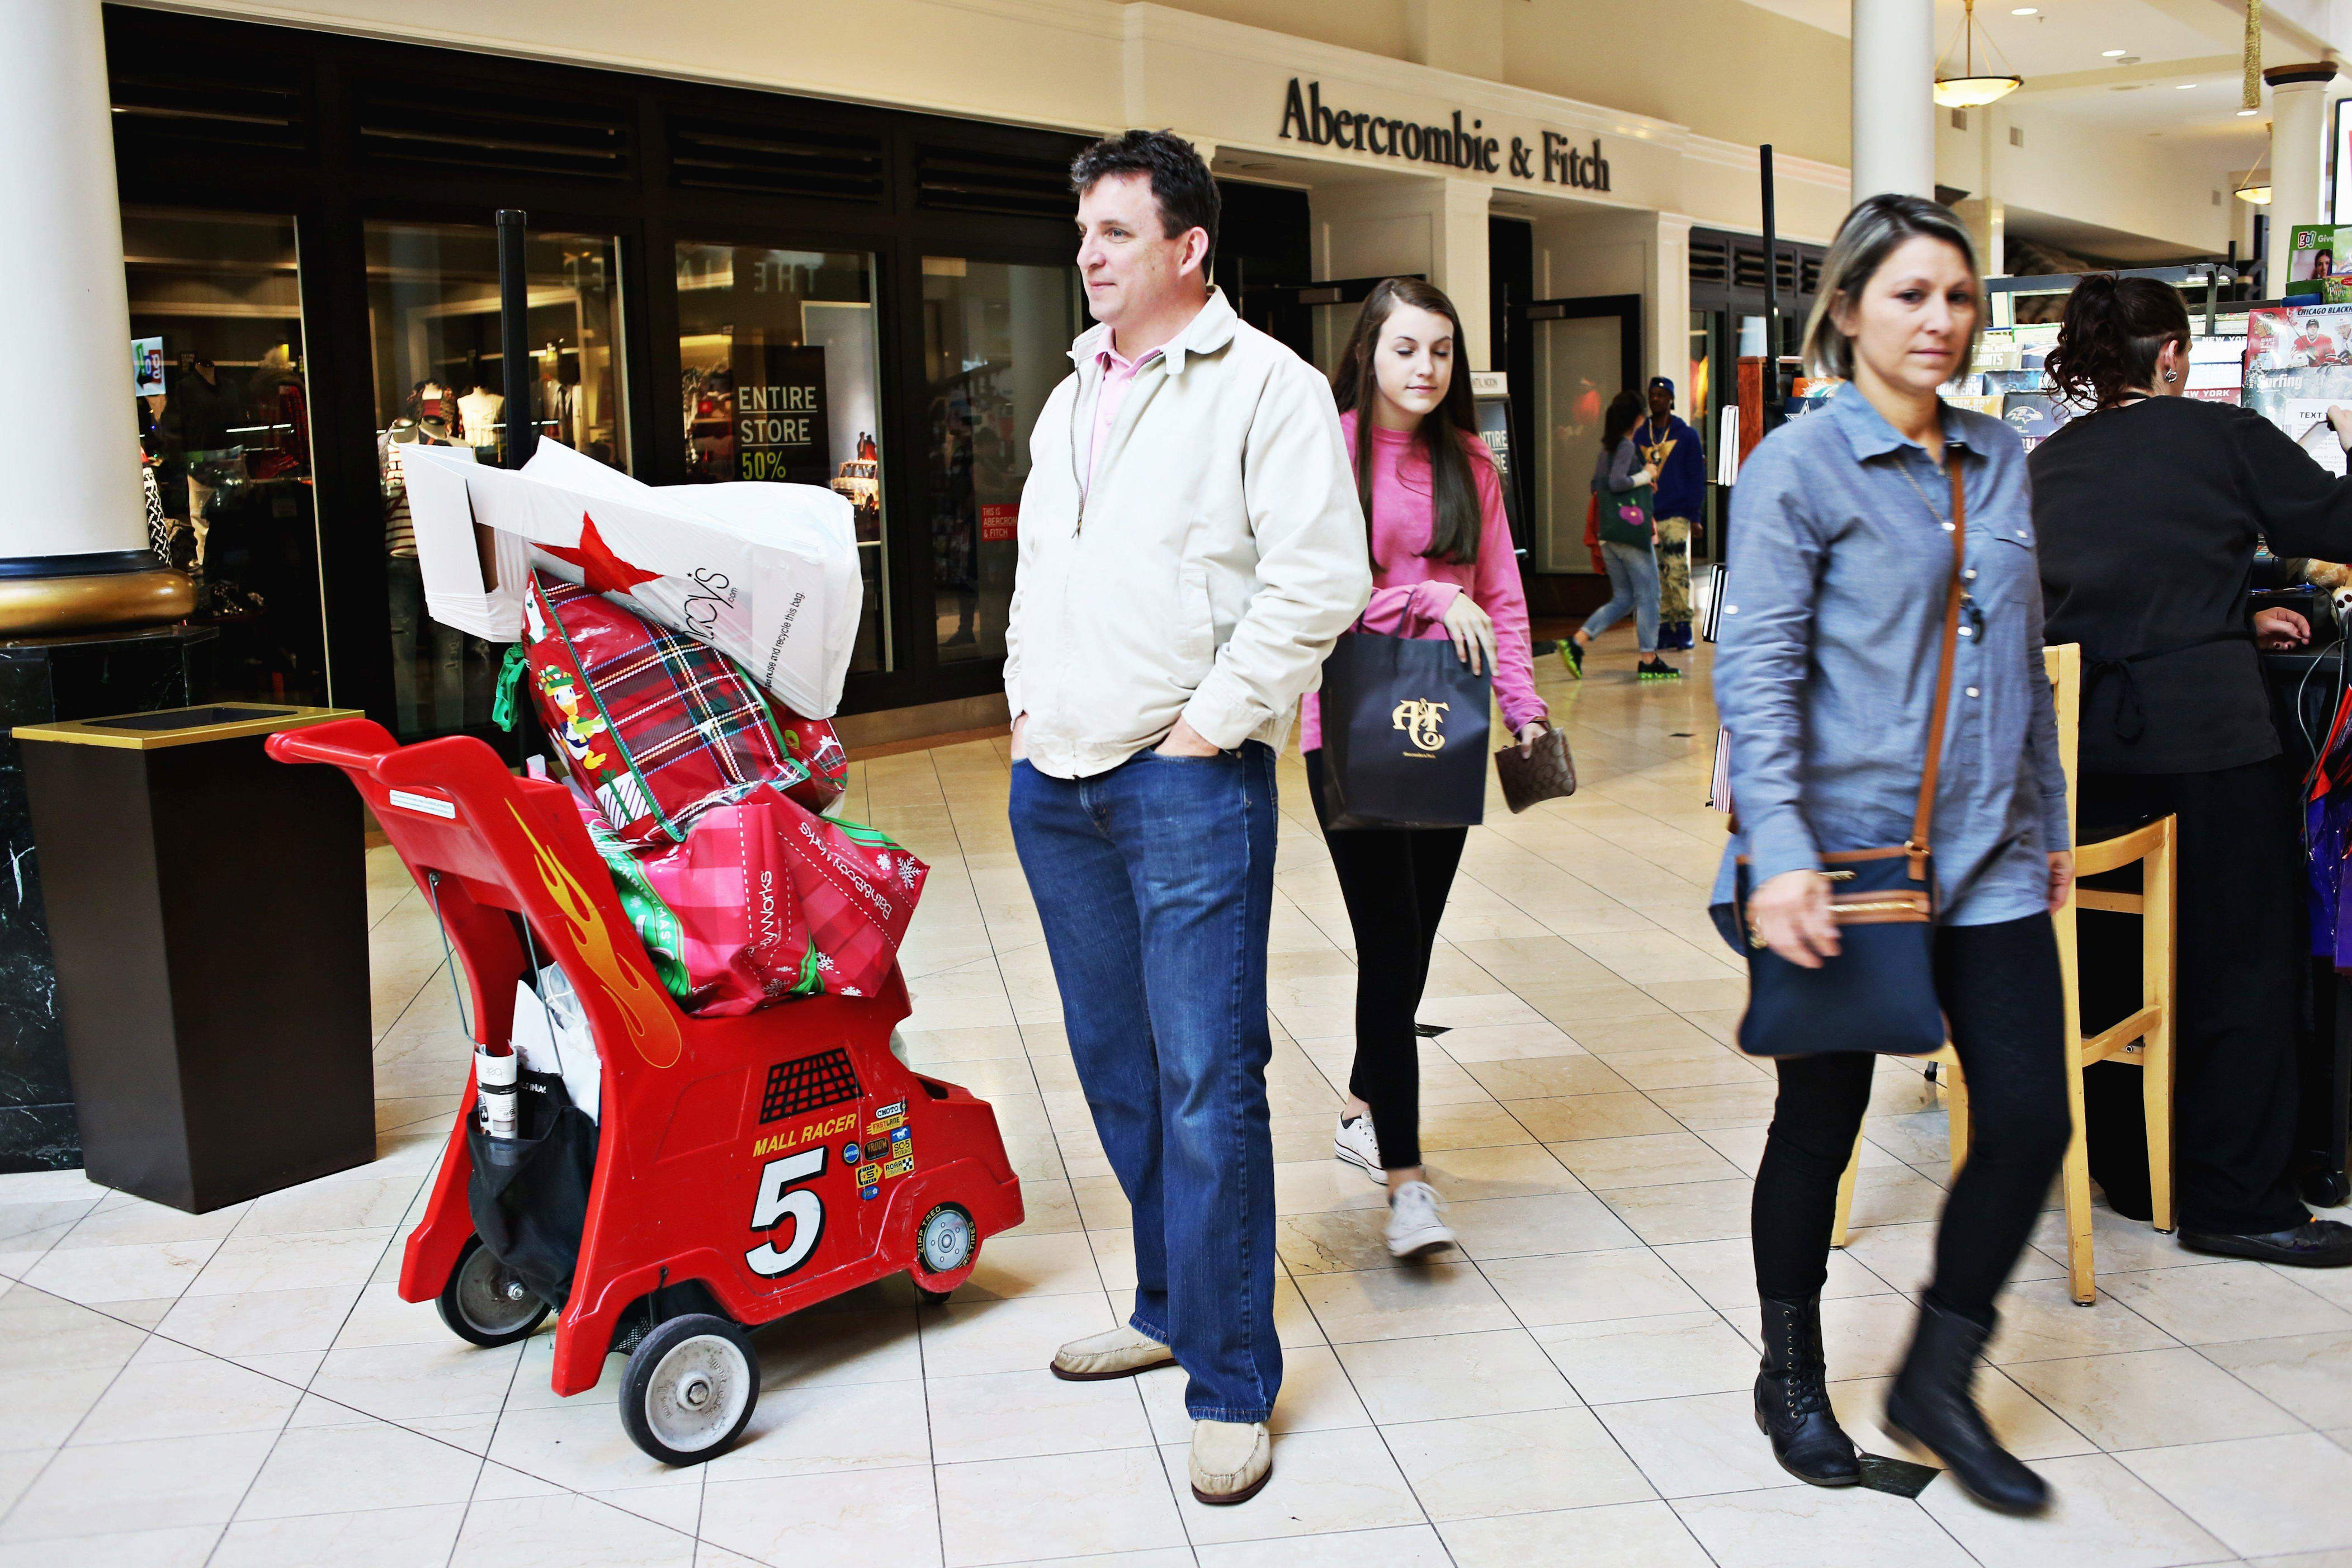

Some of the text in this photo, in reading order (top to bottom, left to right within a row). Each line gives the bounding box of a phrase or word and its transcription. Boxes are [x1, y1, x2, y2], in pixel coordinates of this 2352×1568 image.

[1279, 77, 1610, 191] Abercrombie & Fitch
[2257, 374, 2303, 390] Surfing
[738, 386, 818, 410] ENTIRE
[741, 419, 811, 443] STORE
[742, 451, 786, 480] 50%
[990, 528, 1008, 537] FITCH
[790, 592, 805, 607] bag.
[785, 608, 797, 621] this
[776, 622, 791, 648] recycle
[752, 1113, 857, 1157] MALL RACER
[745, 1146, 828, 1278] 5
[922, 1206, 941, 1226] TRED
